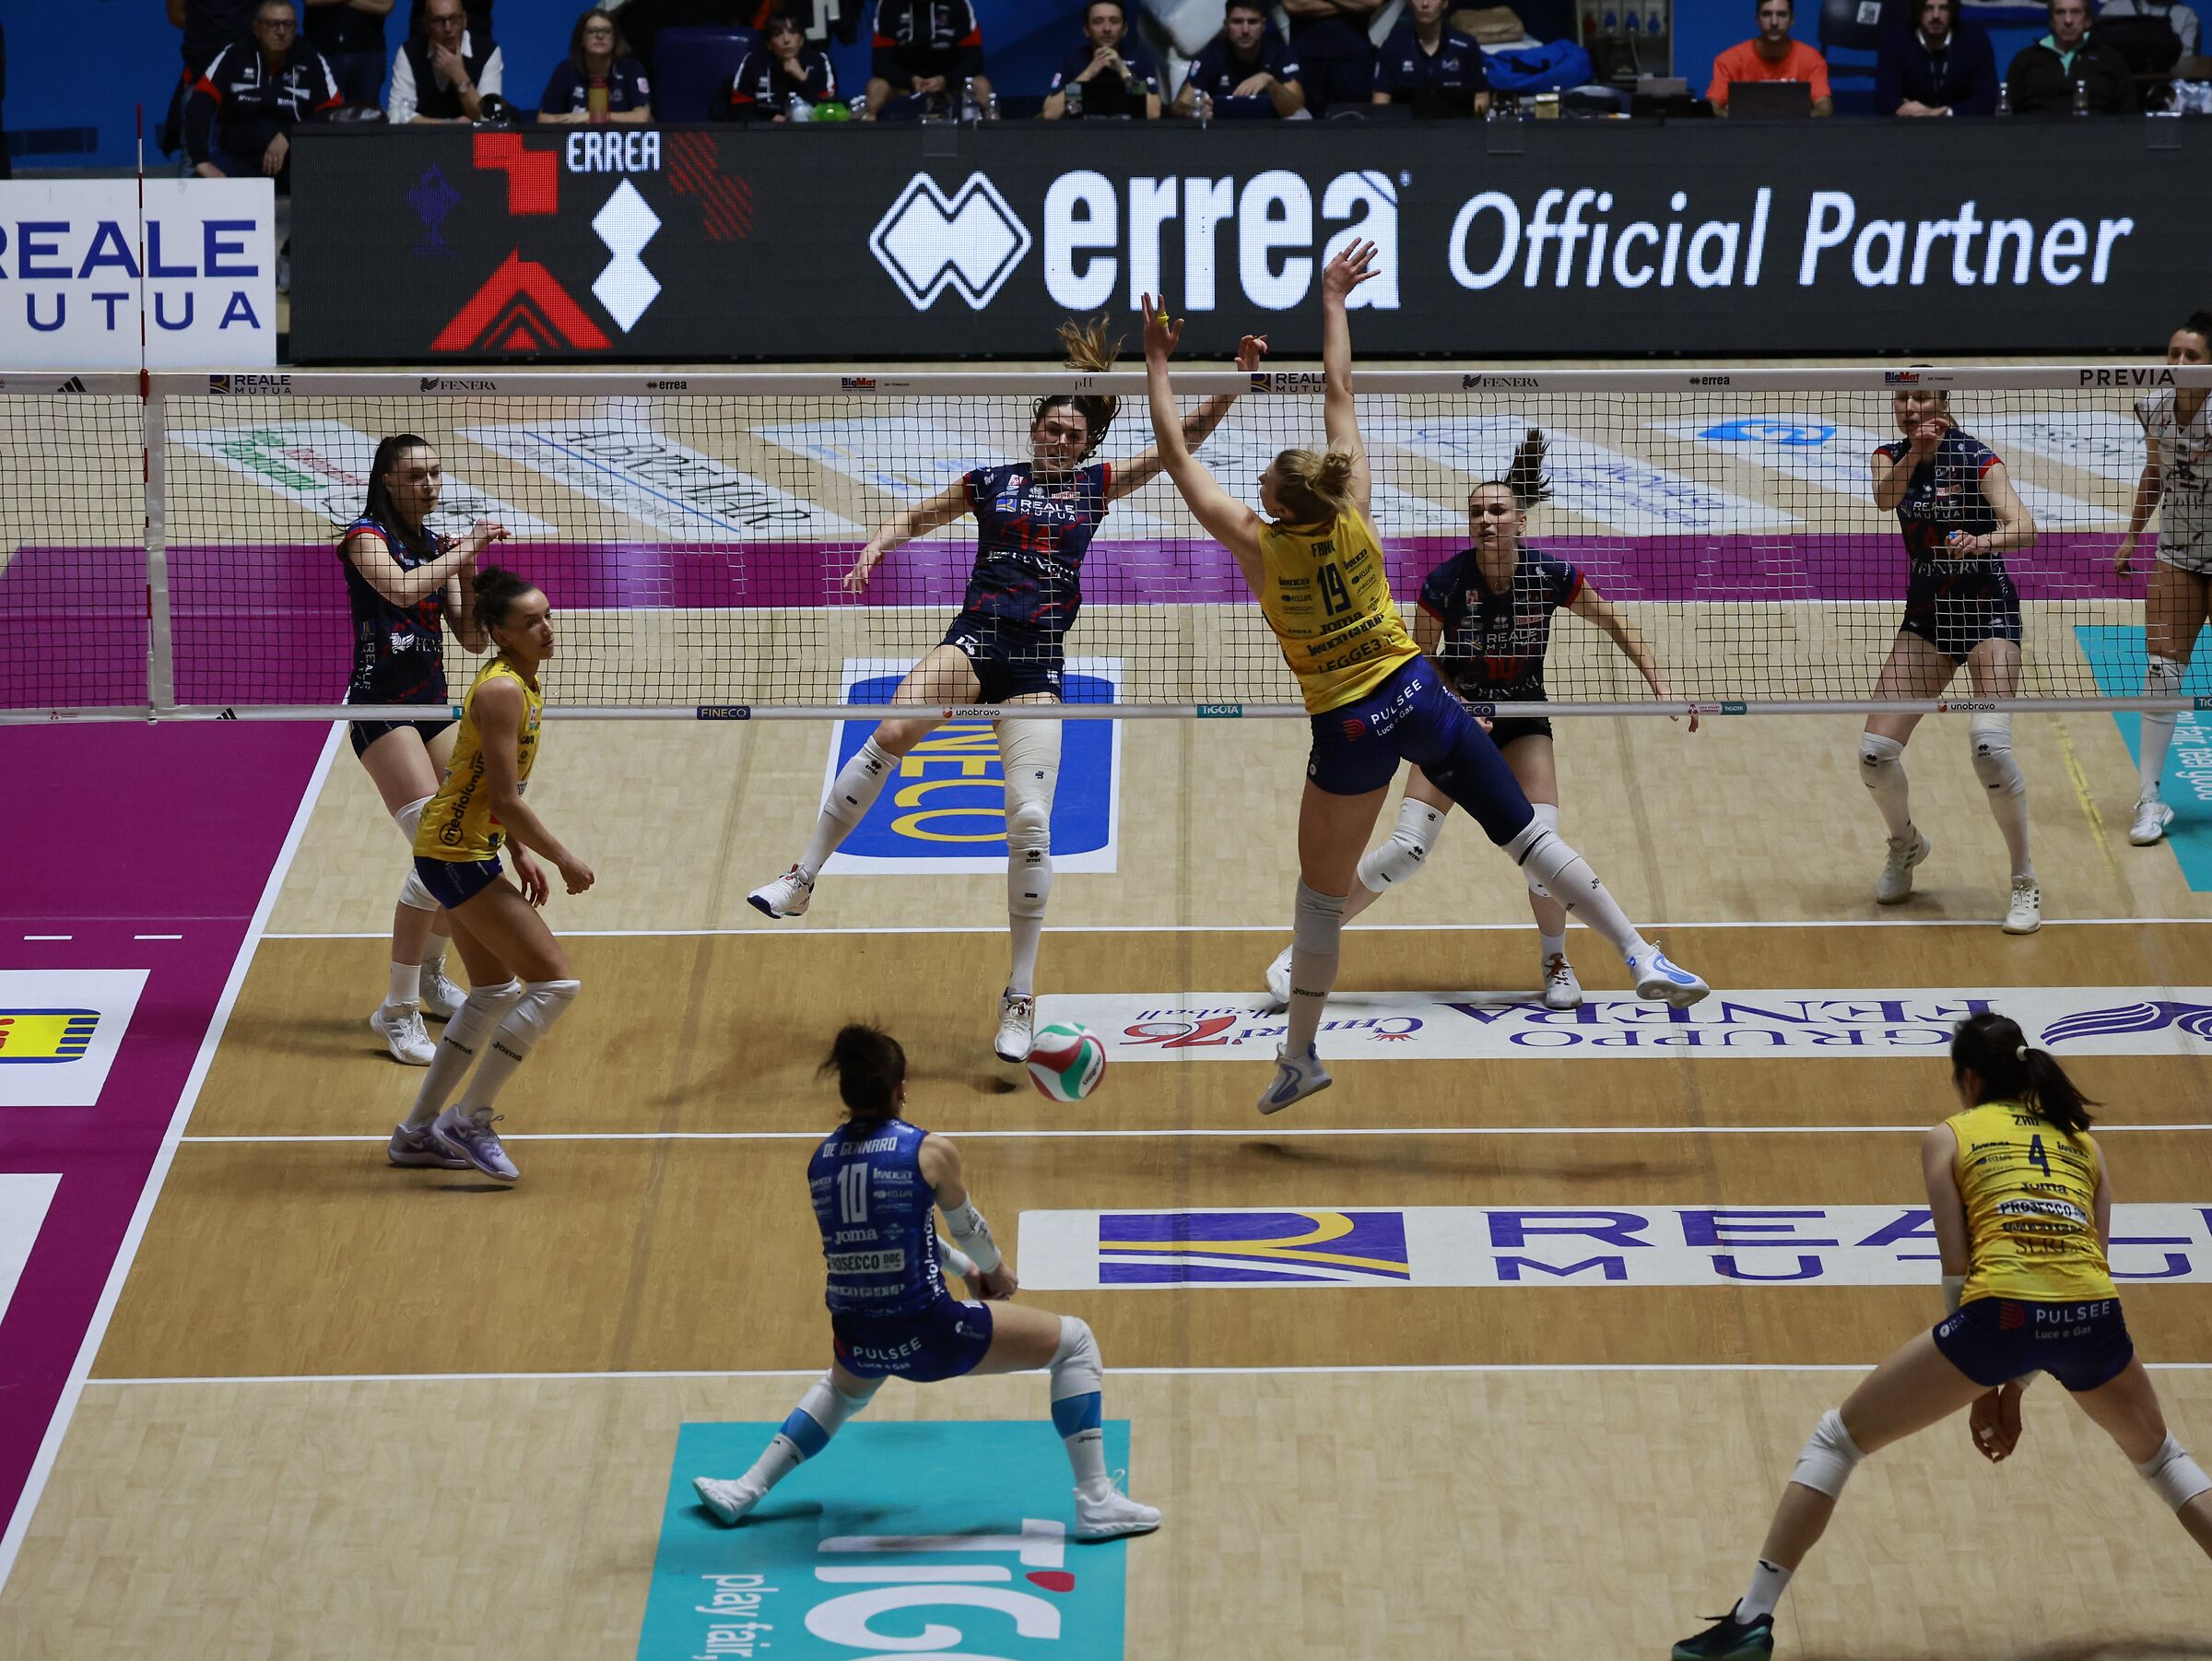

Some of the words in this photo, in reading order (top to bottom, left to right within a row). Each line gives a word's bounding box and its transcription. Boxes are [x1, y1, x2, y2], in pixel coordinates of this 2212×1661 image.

[567, 131, 660, 172] ERREA
[1043, 170, 1400, 312] errea
[1450, 187, 1771, 289] Official
[1799, 191, 2133, 286] Partner
[27, 291, 261, 331] UTUA
[234, 375, 291, 386] REALE
[658, 380, 688, 390] errea
[841, 377, 877, 388] BigMat
[1482, 377, 1539, 387] FENERA
[1701, 375, 1730, 385] errea
[1885, 371, 1920, 383] BigMat
[2079, 369, 2176, 386] PREVIA
[441, 381, 497, 391] FENERA
[1020, 499, 1076, 514] REALE
[1020, 508, 1077, 522] MUTUA
[1316, 562, 1352, 617] 19
[1486, 629, 1537, 643] REALE
[1371, 678, 1423, 725] PULSEE
[1950, 701, 1995, 711] unobravo
[701, 707, 747, 718] FINECO
[956, 707, 1000, 717] unobravo
[1399, 703, 1415, 719] Gas
[890, 724, 1009, 842] NECO
[1508, 1030, 1952, 1048] GRUPPO
[822, 1142, 835, 1159] DE
[840, 1137, 899, 1157] GENNARO
[2028, 1134, 2051, 1178] 4
[837, 1162, 869, 1224] 10
[1999, 1201, 2073, 1218] PROSECCO
[2036, 1301, 2111, 1324] PULSEE
[2035, 1328, 2060, 1339] Luce
[2073, 1325, 2092, 1337] Gas
[853, 1337, 923, 1361] PULSEE
[695, 1573, 780, 1618] play
[692, 1621, 774, 1661] fair,
